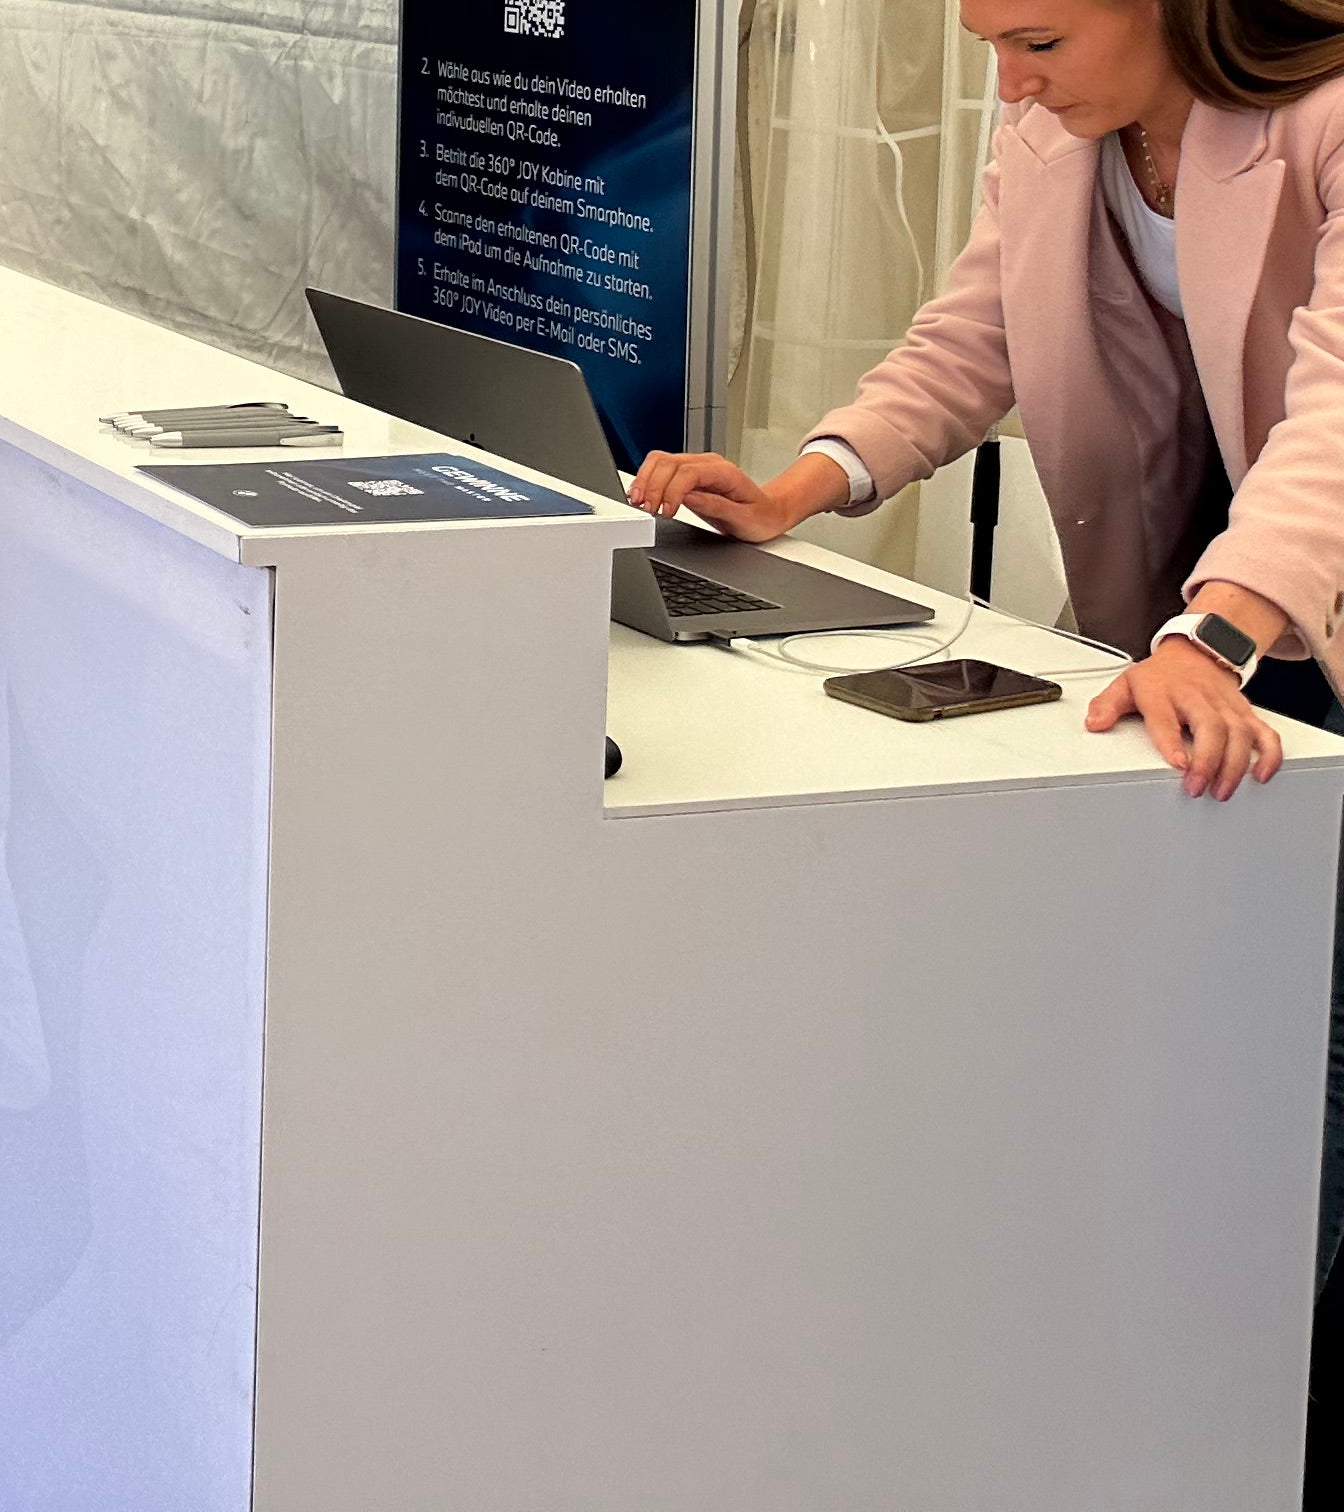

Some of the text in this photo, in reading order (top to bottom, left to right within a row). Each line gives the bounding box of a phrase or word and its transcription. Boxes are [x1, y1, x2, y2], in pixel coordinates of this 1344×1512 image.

[437, 59, 469, 82] Wähle
[470, 69, 491, 85] aus
[492, 70, 512, 88] wie
[514, 71, 529, 91] du
[531, 75, 556, 95] dein
[556, 77, 592, 101] Video
[594, 85, 647, 109] erhalten
[437, 85, 592, 127] möchtest und erhalte deinen
[506, 120, 562, 148] QR-Code.
[419, 139, 606, 196] 3. Betritt die 360° JOY Kabine mit
[435, 168, 654, 233] dem QR-Code auf deinem Smarphone.
[418, 199, 640, 270] 4. Scanne den erhaltenen QR-Code mit
[433, 227, 654, 301] dem iPad um die Aufnahme zu starten.
[417, 257, 653, 341] 5. Erhalte im Anschluss dein persönliches
[432, 285, 642, 365] 360° JOY Video per E-Mail oder SMS.
